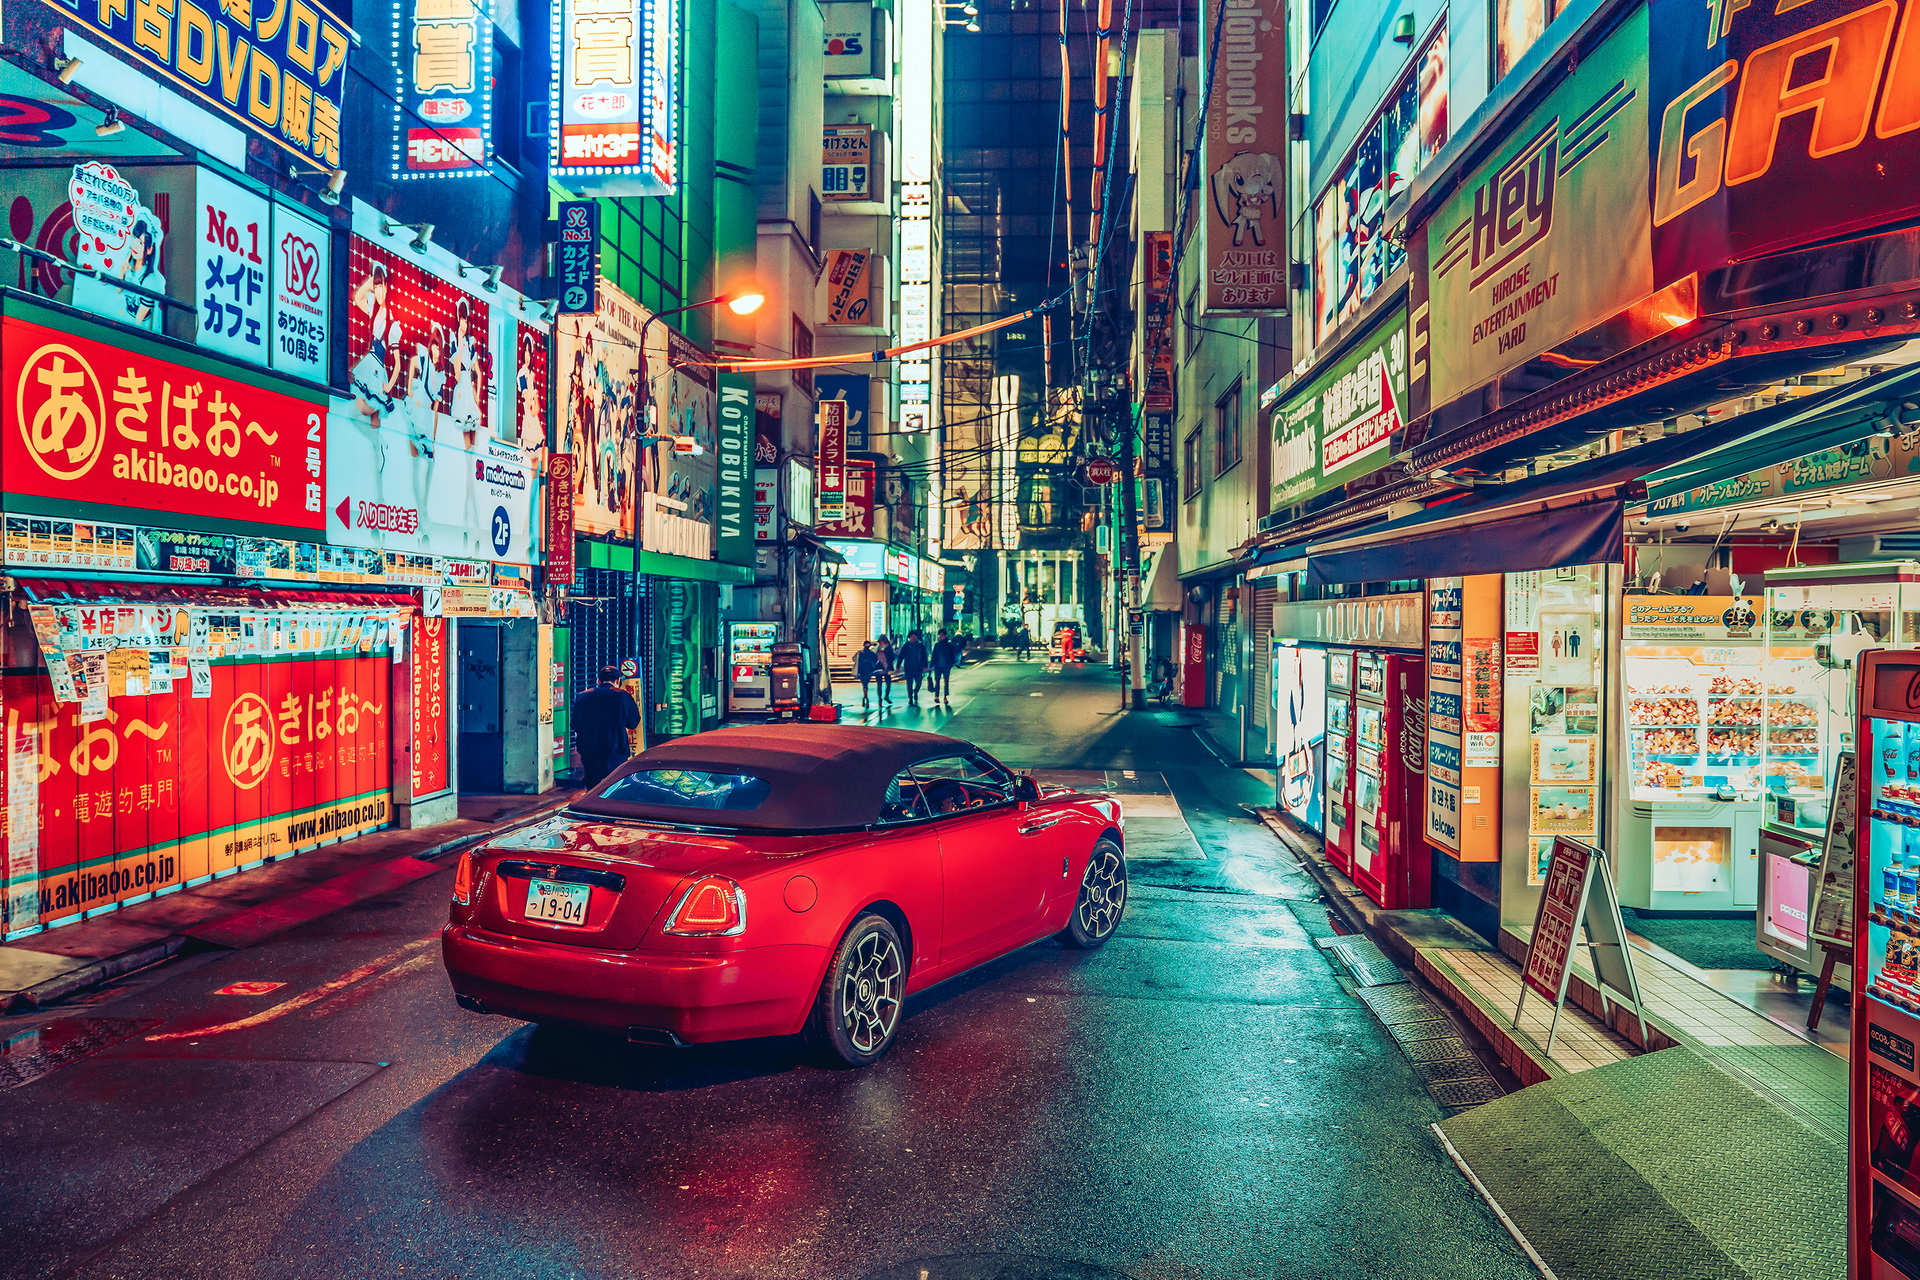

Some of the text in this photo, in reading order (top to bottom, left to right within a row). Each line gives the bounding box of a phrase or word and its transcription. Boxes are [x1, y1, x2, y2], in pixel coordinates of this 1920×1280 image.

[1654, 0, 1920, 227] GA
[206, 204, 263, 265] No.1
[563, 229, 592, 242] No.1
[563, 244, 576, 283] カフェ
[578, 244, 590, 286] メイド
[1211, 268, 1286, 286] ビル正面に
[1222, 250, 1276, 267] 入り口は
[205, 254, 264, 306] メイド
[567, 291, 585, 305] 2F
[1222, 287, 1275, 304] あります
[1492, 262, 1531, 307] HIROSE
[203, 293, 261, 346] カフェ
[277, 310, 325, 343] ありがとう
[1472, 272, 1560, 345] ENTERTAINMENT
[279, 334, 319, 365] 10周年
[1497, 321, 1527, 356] YARD
[112, 447, 279, 508] akibaoo.co.jp
[305, 412, 322, 513] 2号店
[486, 464, 526, 490] maidreamin
[721, 386, 749, 538] KOTOBUKIYA
[356, 500, 419, 535] 入り口は左手
[494, 515, 509, 546] 2F
[1191, 631, 1203, 664] Coca-Cola
[1402, 693, 1426, 775] Coca-Cola
[287, 798, 386, 845] www.akibaoo.co.jp
